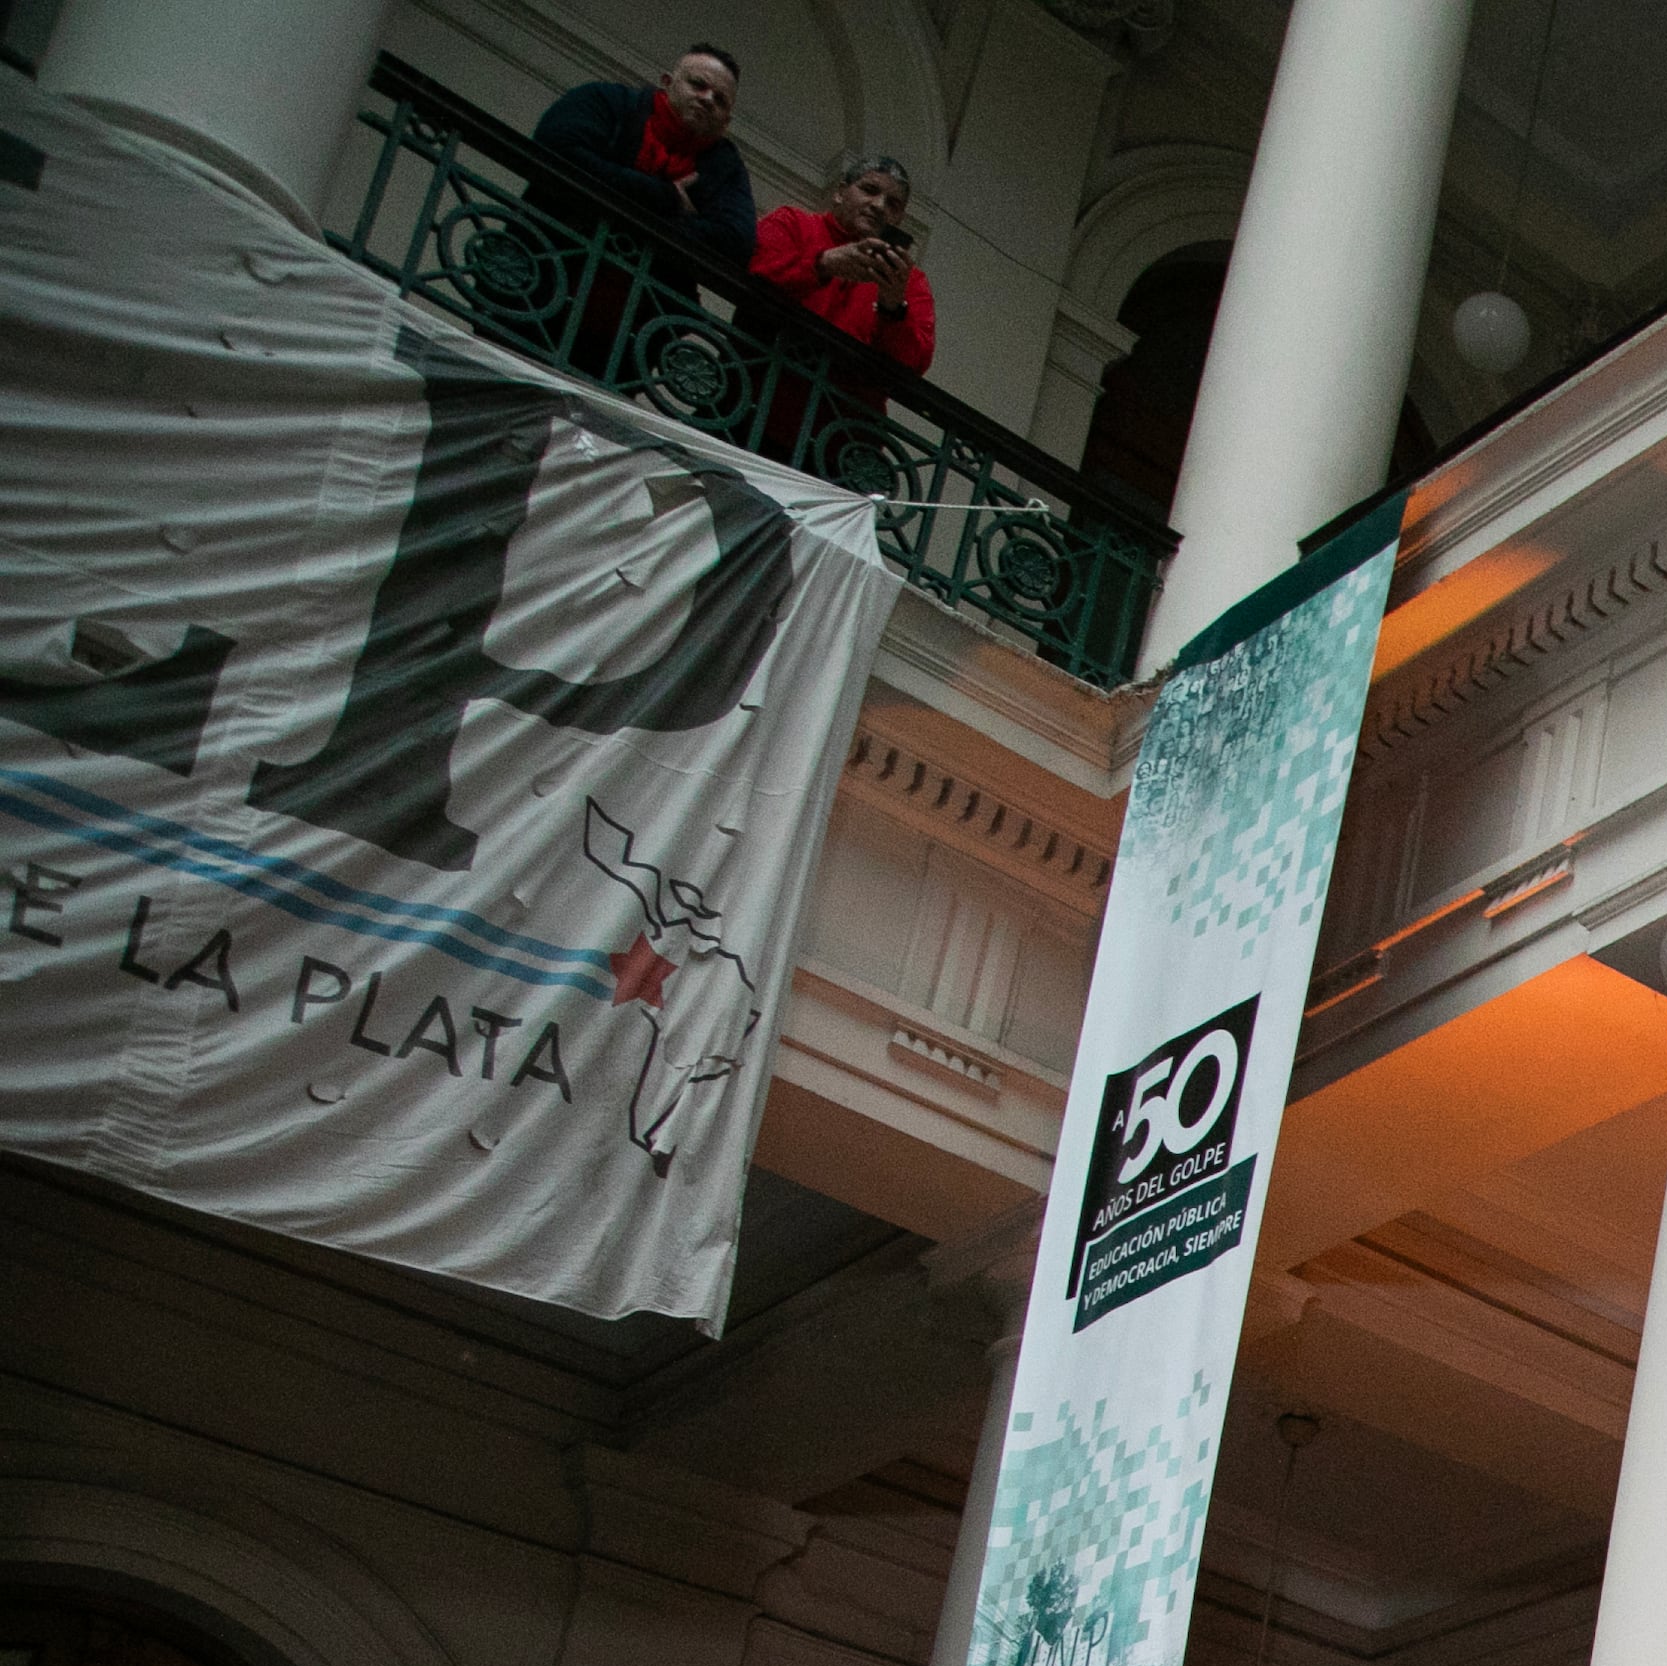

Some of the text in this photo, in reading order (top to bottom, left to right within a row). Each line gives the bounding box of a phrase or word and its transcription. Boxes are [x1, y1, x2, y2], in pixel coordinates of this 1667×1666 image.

[119, 895, 240, 1013] LA
[290, 955, 574, 1104] PLATA
[1112, 1029, 1238, 1184] A 50
[1088, 1192, 1227, 1281] EDUCACIÓN PÚBLICA
[1092, 1142, 1226, 1232] AÑOS DEL GOLPE
[1083, 1210, 1242, 1311] Y DEMOCRACIA, SIEMPRE
